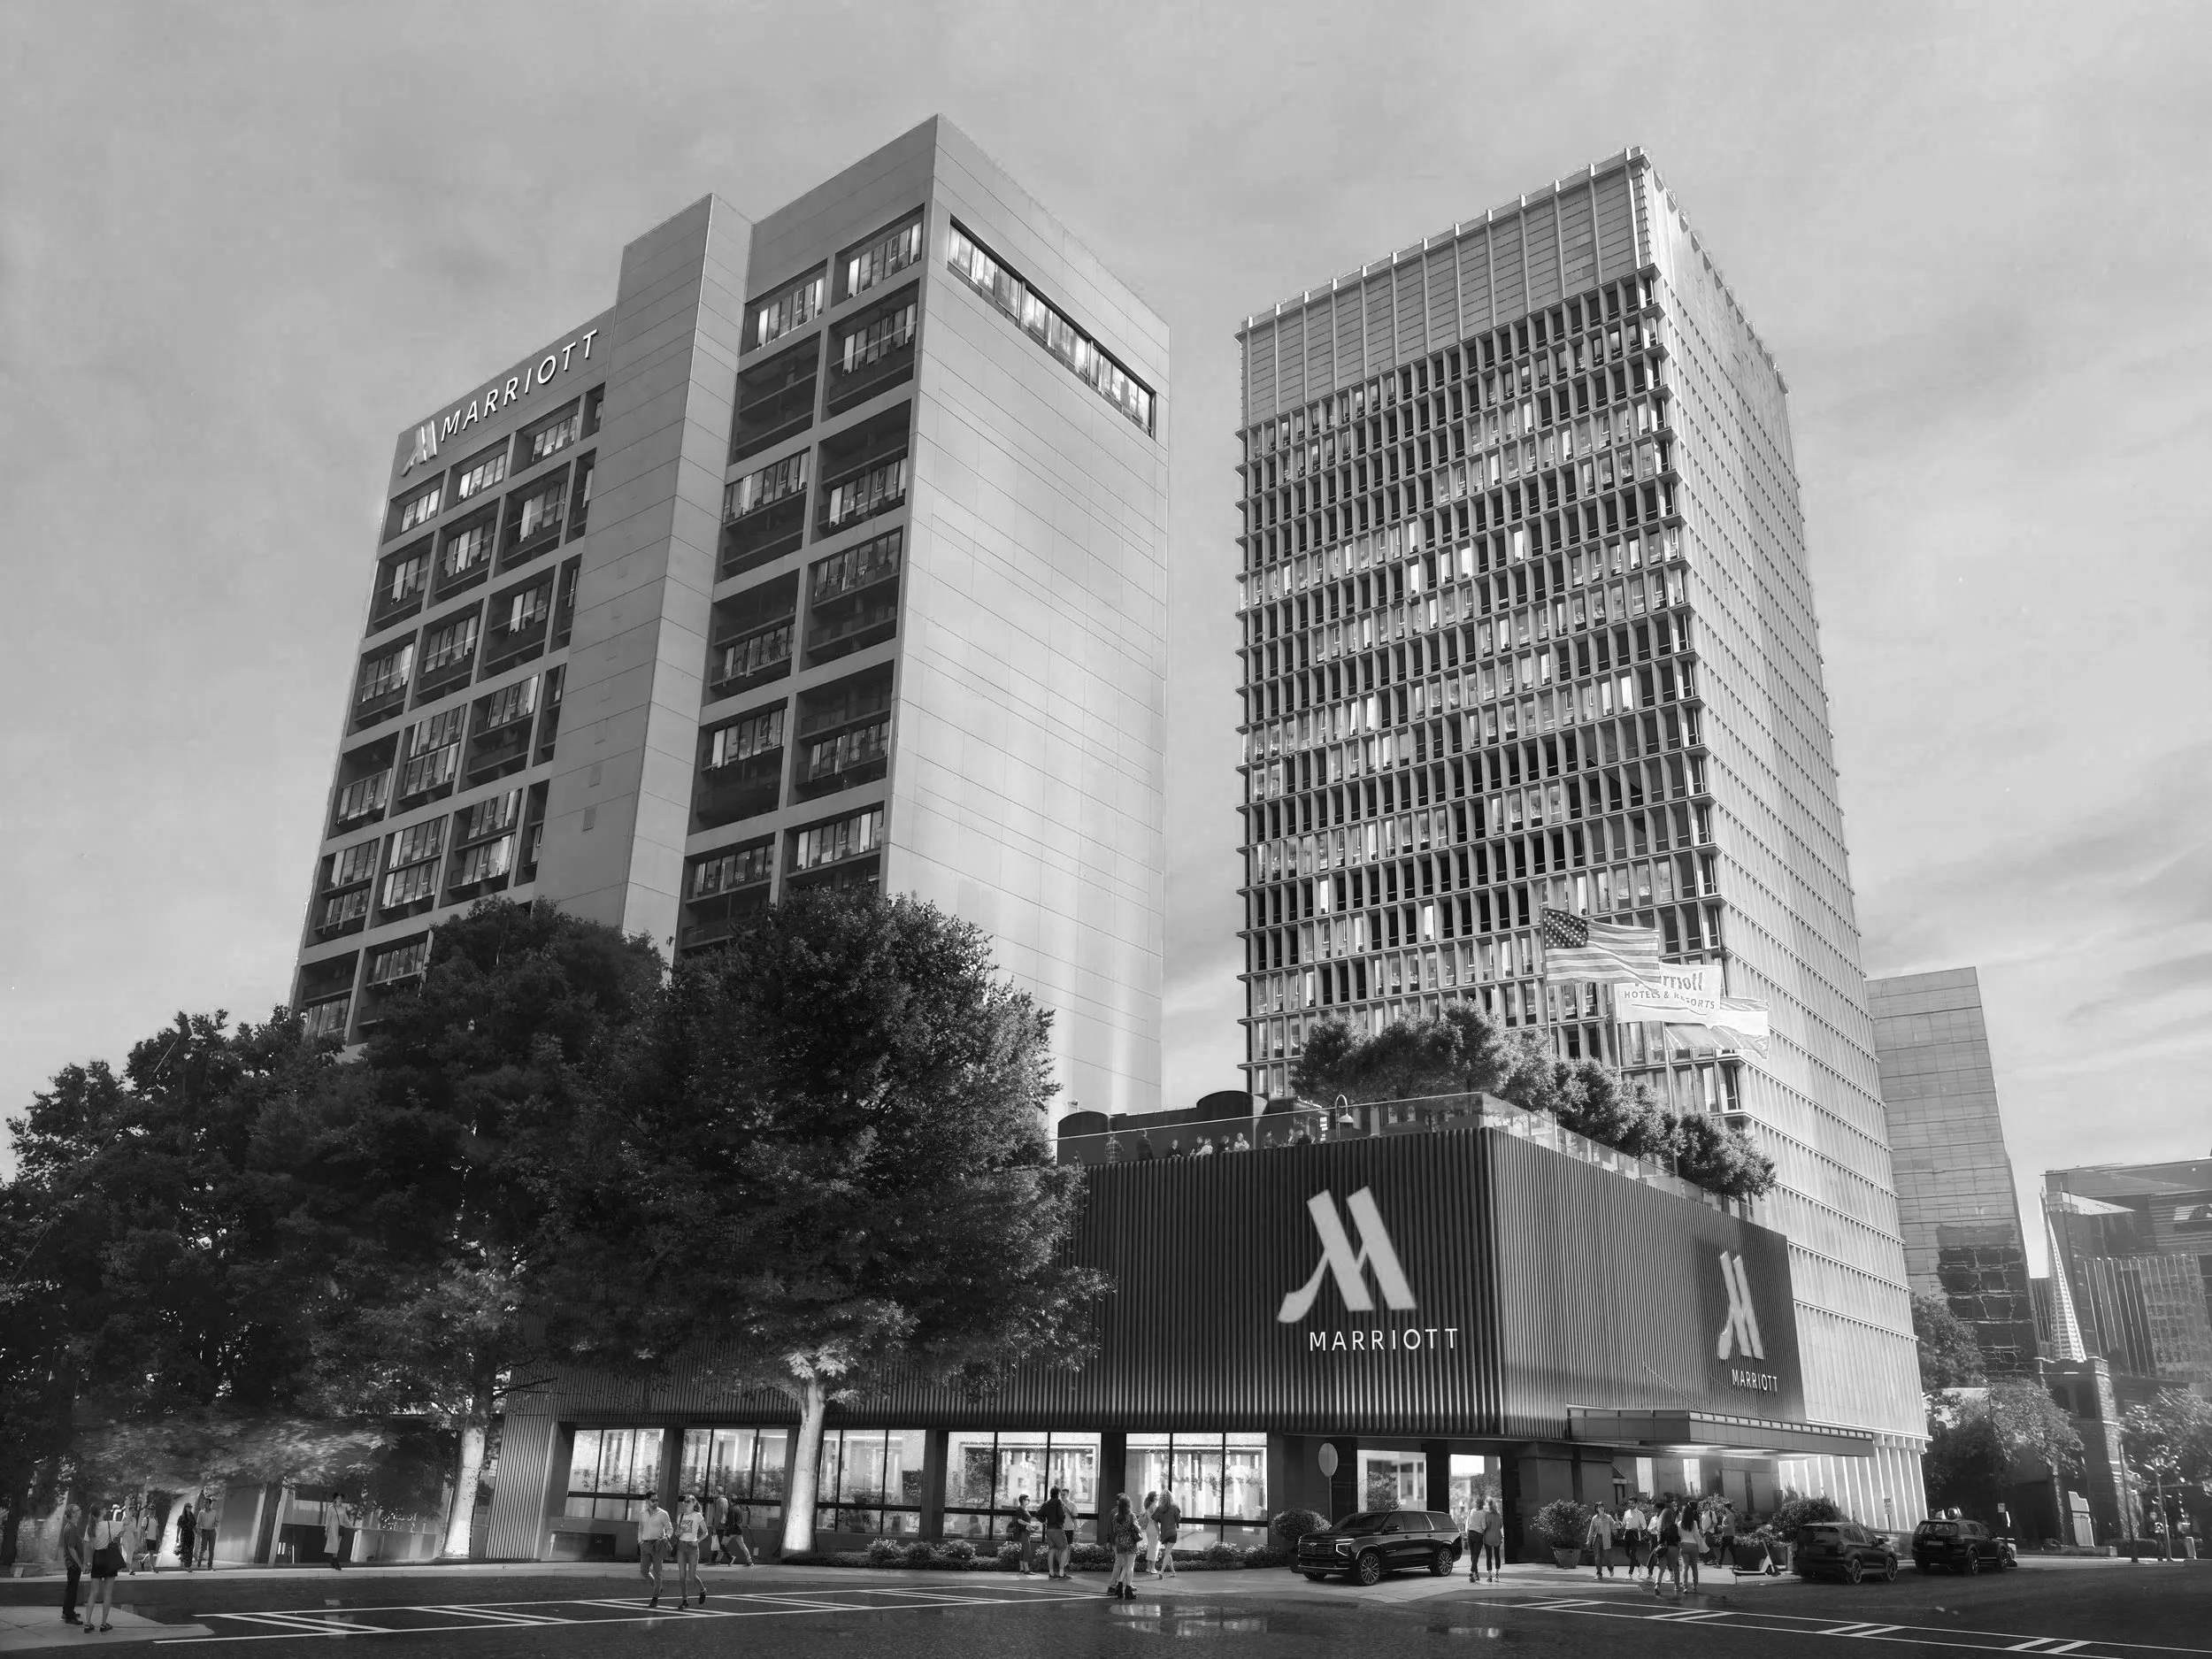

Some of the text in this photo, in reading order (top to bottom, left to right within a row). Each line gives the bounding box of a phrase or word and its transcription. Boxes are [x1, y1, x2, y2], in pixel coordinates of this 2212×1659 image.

[441, 328, 599, 442] MARRIOTT
[1663, 972, 1703, 991] rriott
[1310, 1328, 1458, 1352] MARRIOTT
[1732, 1368, 1778, 1393] MARRIOTT
